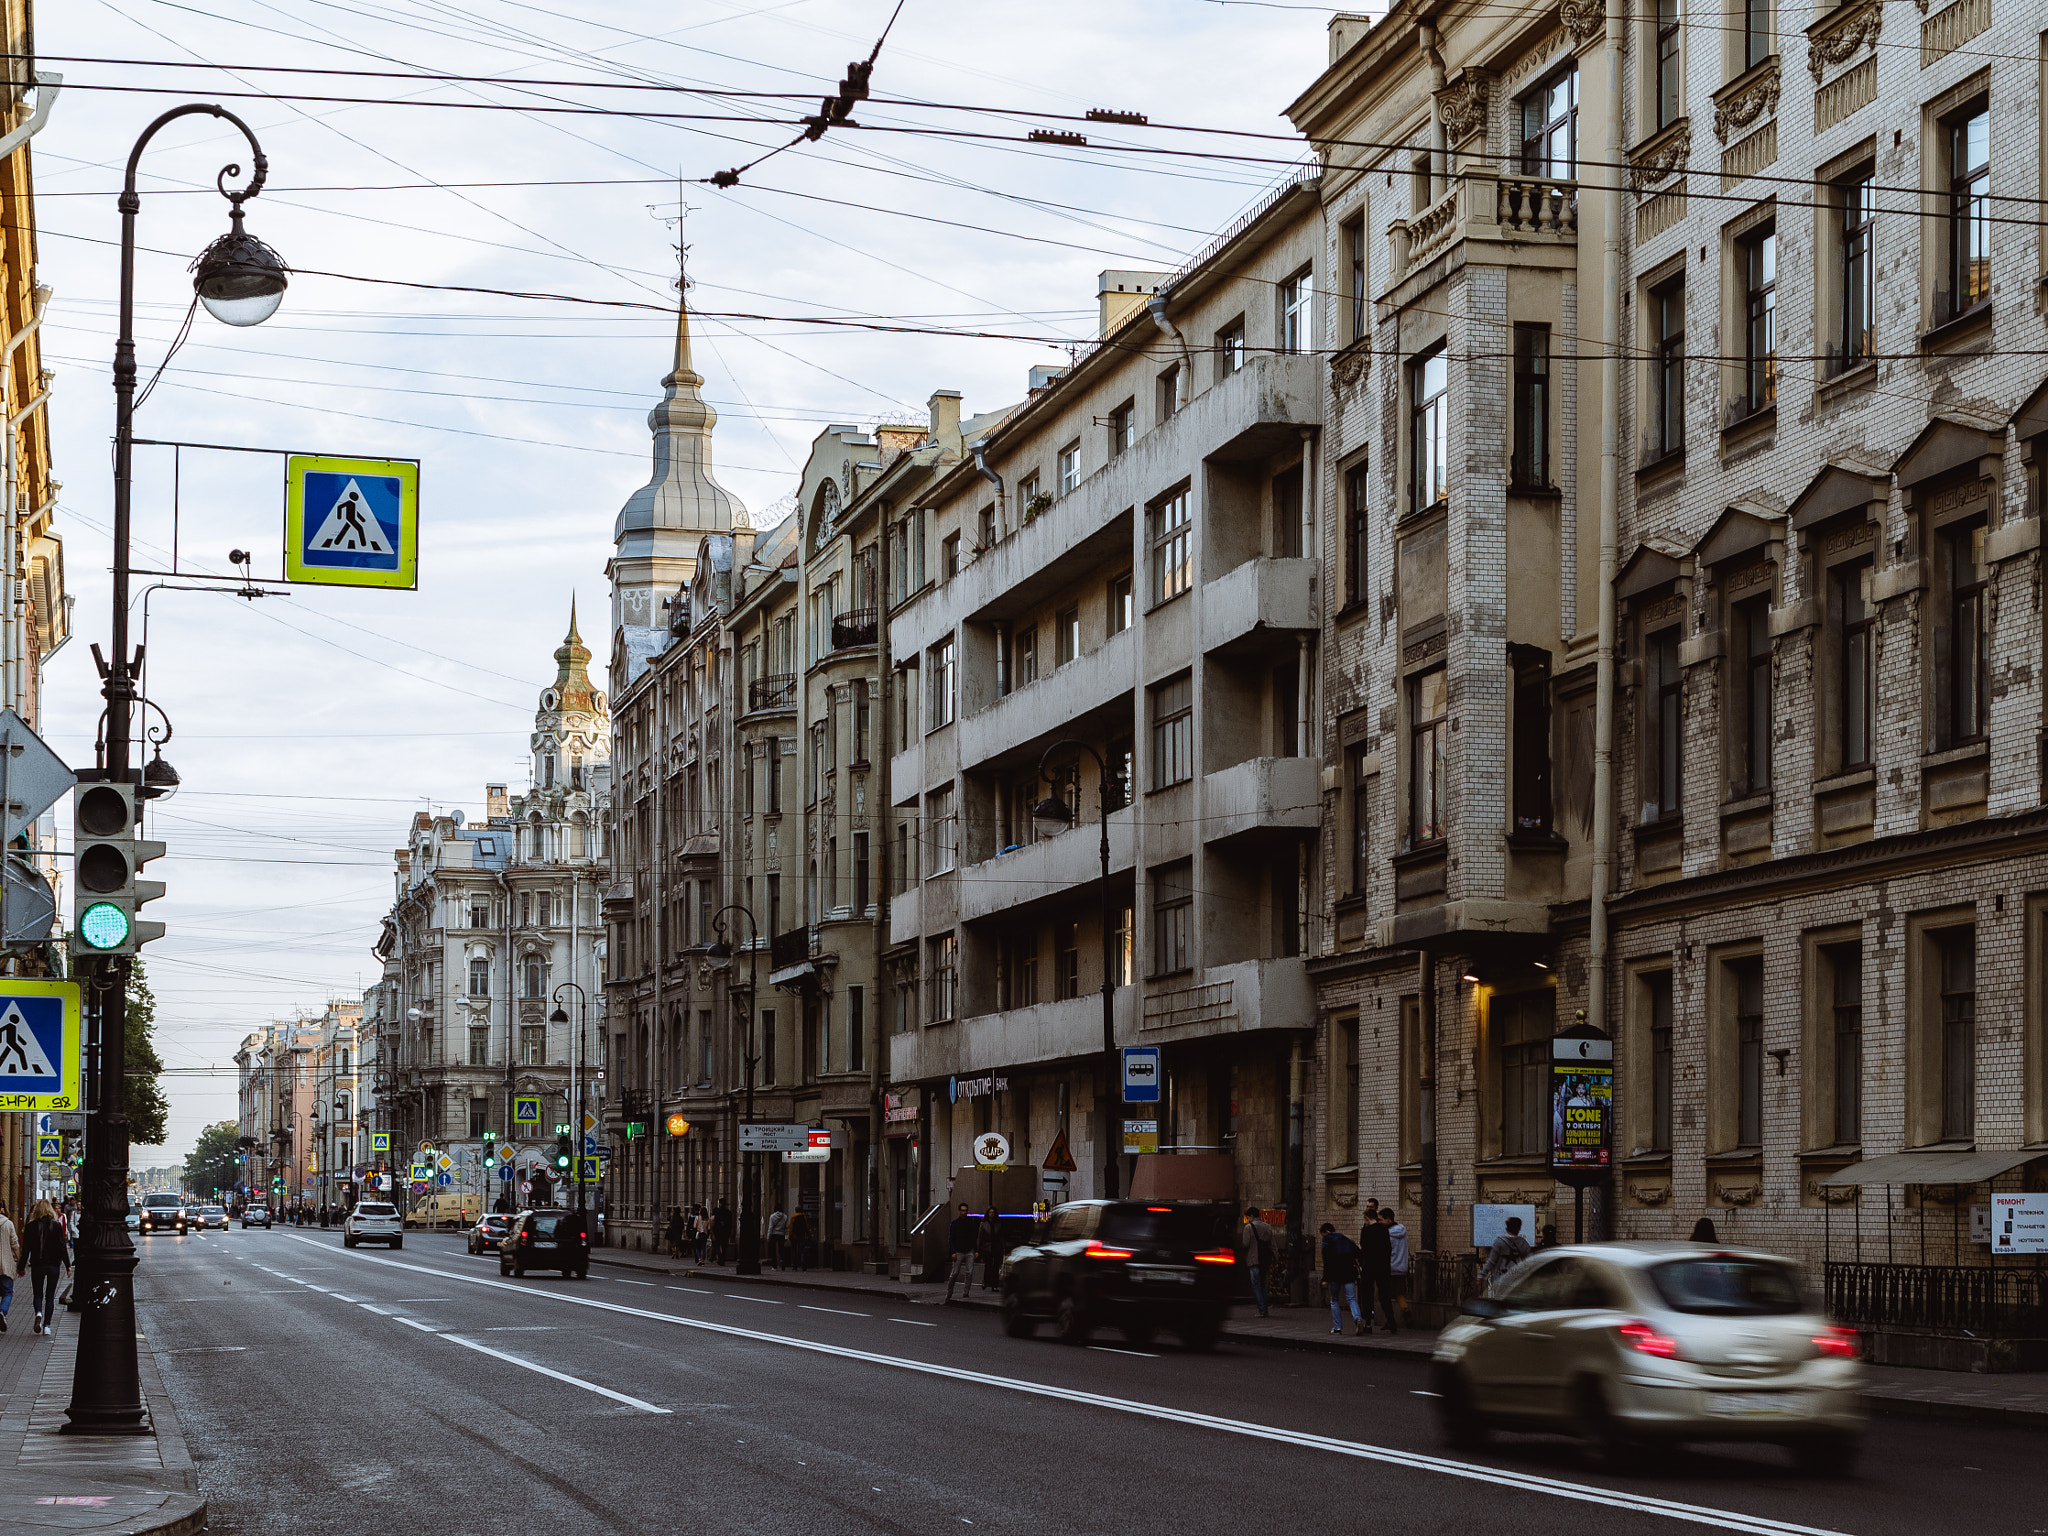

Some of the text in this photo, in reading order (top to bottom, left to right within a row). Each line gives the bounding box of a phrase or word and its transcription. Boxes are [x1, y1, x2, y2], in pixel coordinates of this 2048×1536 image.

[957, 1077, 1009, 1104] открытие БАНК
[1566, 1108, 1602, 1122] L'ONE
[670, 1118, 684, 1128] 24
[1572, 1122, 1601, 1130] ОКТЯБРЯ
[1996, 1198, 2026, 1206] РЕМОНТ
